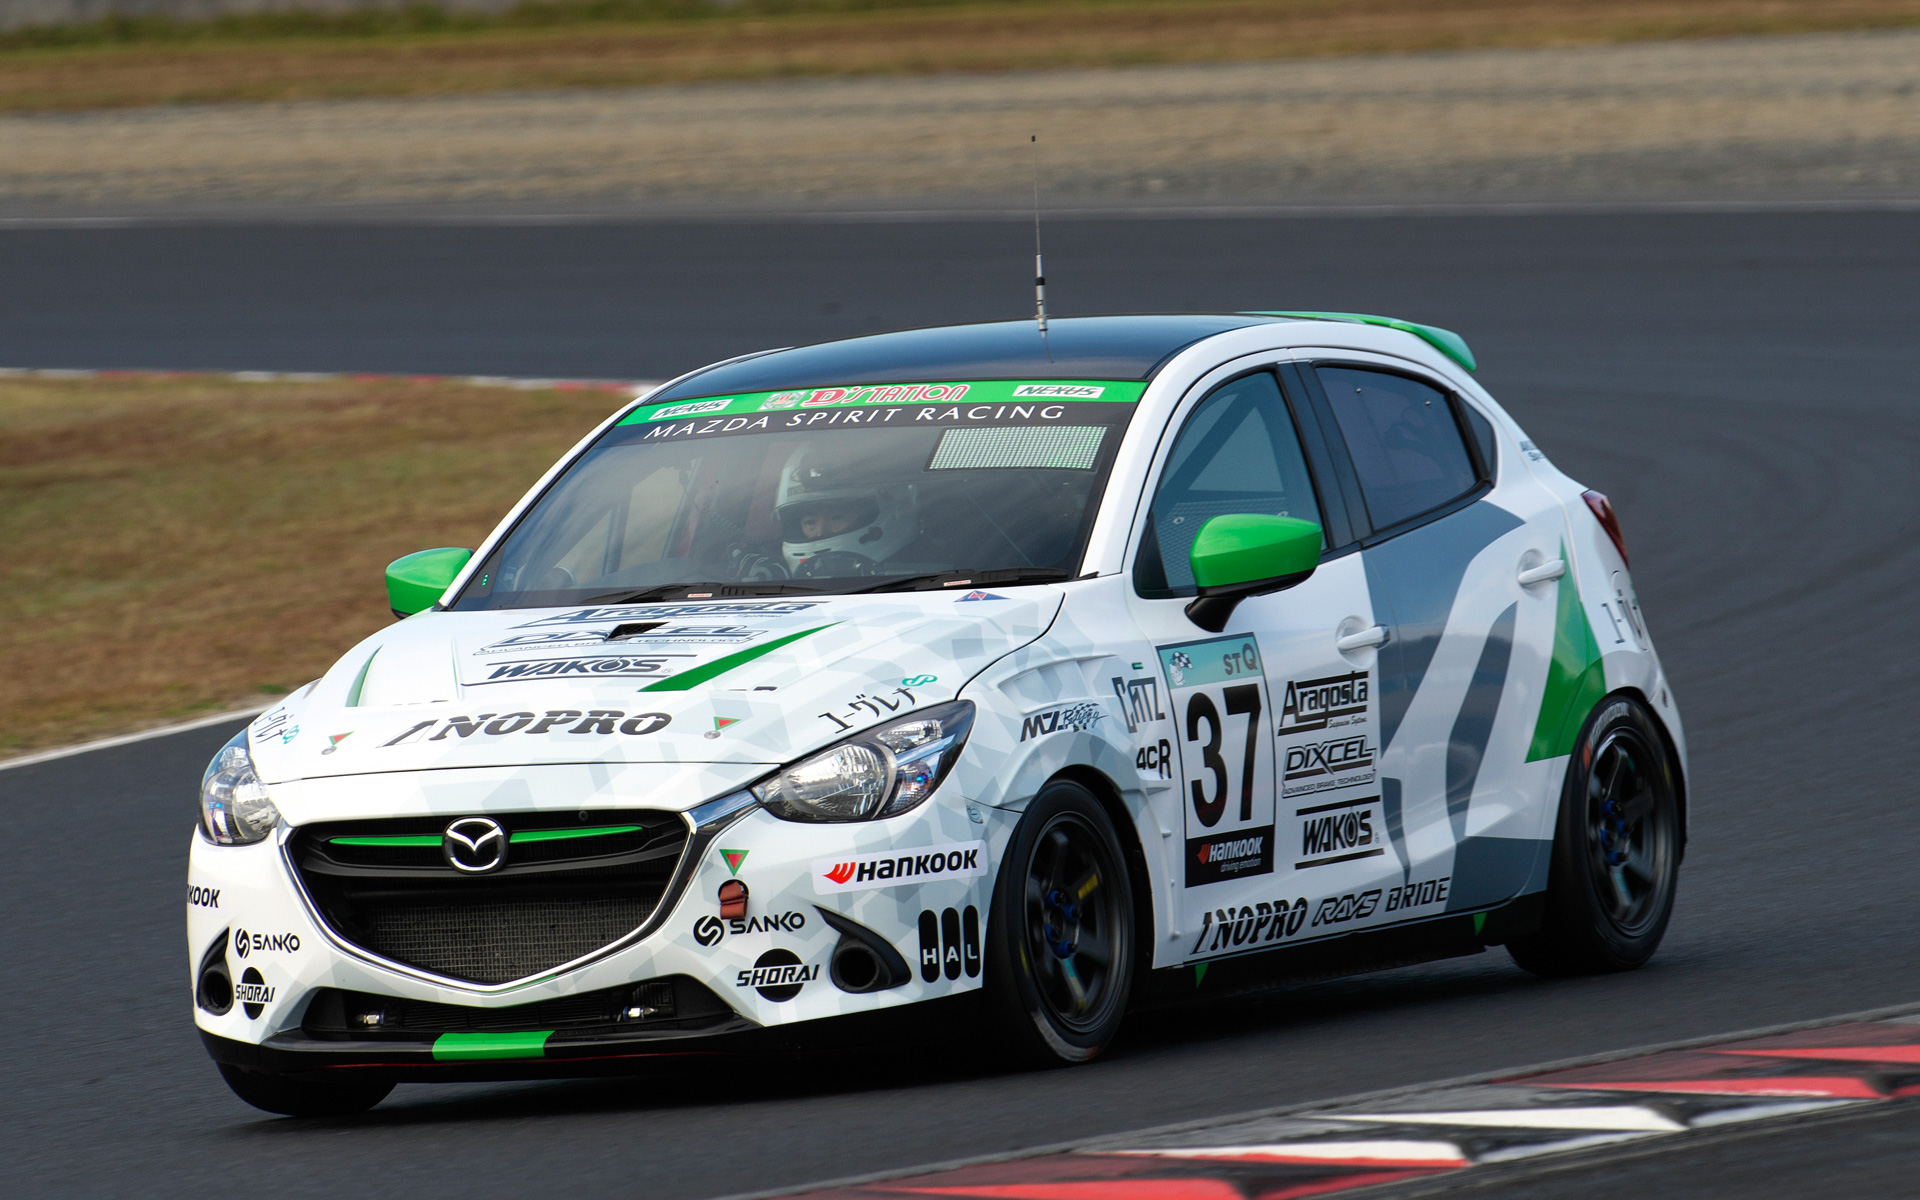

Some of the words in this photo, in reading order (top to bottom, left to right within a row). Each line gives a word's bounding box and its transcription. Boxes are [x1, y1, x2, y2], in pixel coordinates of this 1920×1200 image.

[1019, 385, 1099, 396] NEXUS
[644, 416, 769, 439] MAZDA
[786, 408, 902, 427] SPIRIT
[915, 404, 1065, 421] RACING
[654, 400, 727, 418] NEXUS
[487, 657, 669, 680] WAKO'S
[1279, 671, 1368, 728] Aragosta
[1136, 738, 1172, 779] 4CR
[1186, 683, 1262, 828] 37
[1286, 739, 1373, 775] DIXCEL
[1283, 783, 1316, 795] ADVANCED
[1316, 780, 1336, 790] BRAKE
[1337, 773, 1375, 786] TECHNOLOGY
[1302, 808, 1372, 857] WAKO'S
[1311, 888, 1383, 928] RAYS
[1385, 876, 1451, 913] BRIDE
[730, 911, 806, 936] SANKO
[253, 932, 301, 953] SANKO
[921, 943, 978, 966] HAL
[736, 963, 821, 988] SHORAI
[235, 984, 276, 1003] SHORAI
